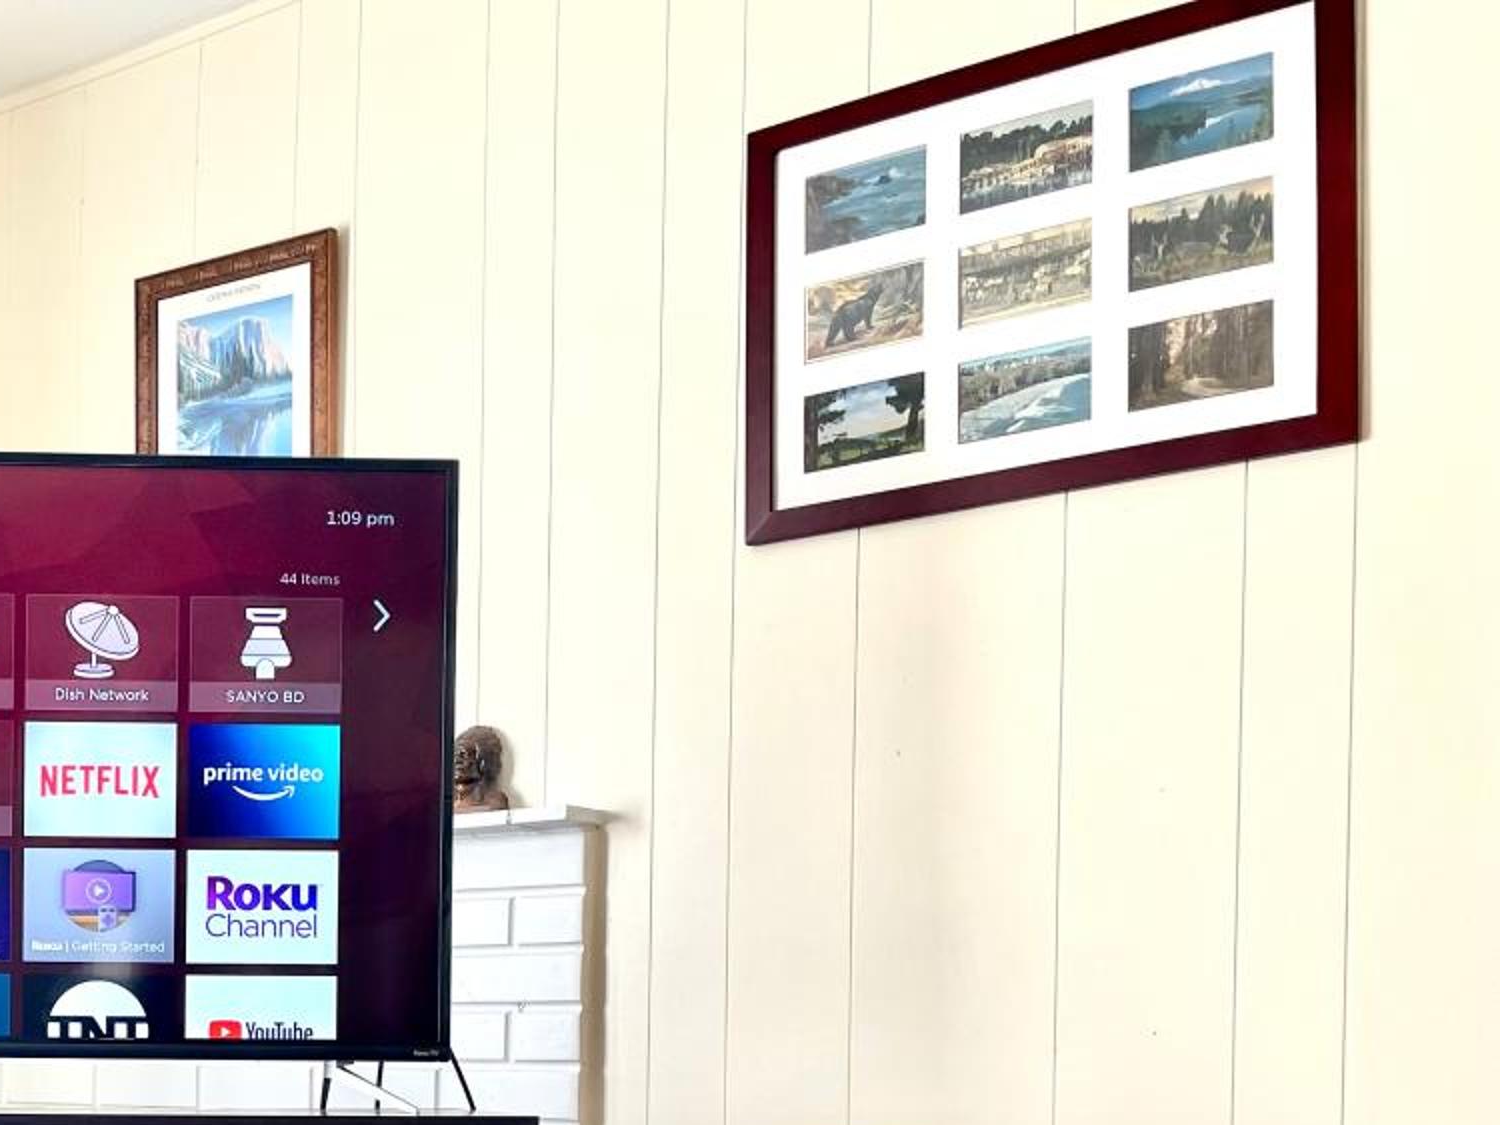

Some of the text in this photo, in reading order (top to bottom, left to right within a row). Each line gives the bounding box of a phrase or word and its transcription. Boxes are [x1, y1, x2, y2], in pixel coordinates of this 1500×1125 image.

[326, 511, 394, 530] 1:09 pm
[279, 573, 340, 586] 44 Items
[55, 687, 149, 702] Dish Network
[226, 690, 305, 704] SANYO BD
[40, 765, 160, 798] NETFLIX
[203, 763, 324, 785] prime video
[206, 913, 317, 938] Channel
[245, 1021, 314, 1039] YouTube
